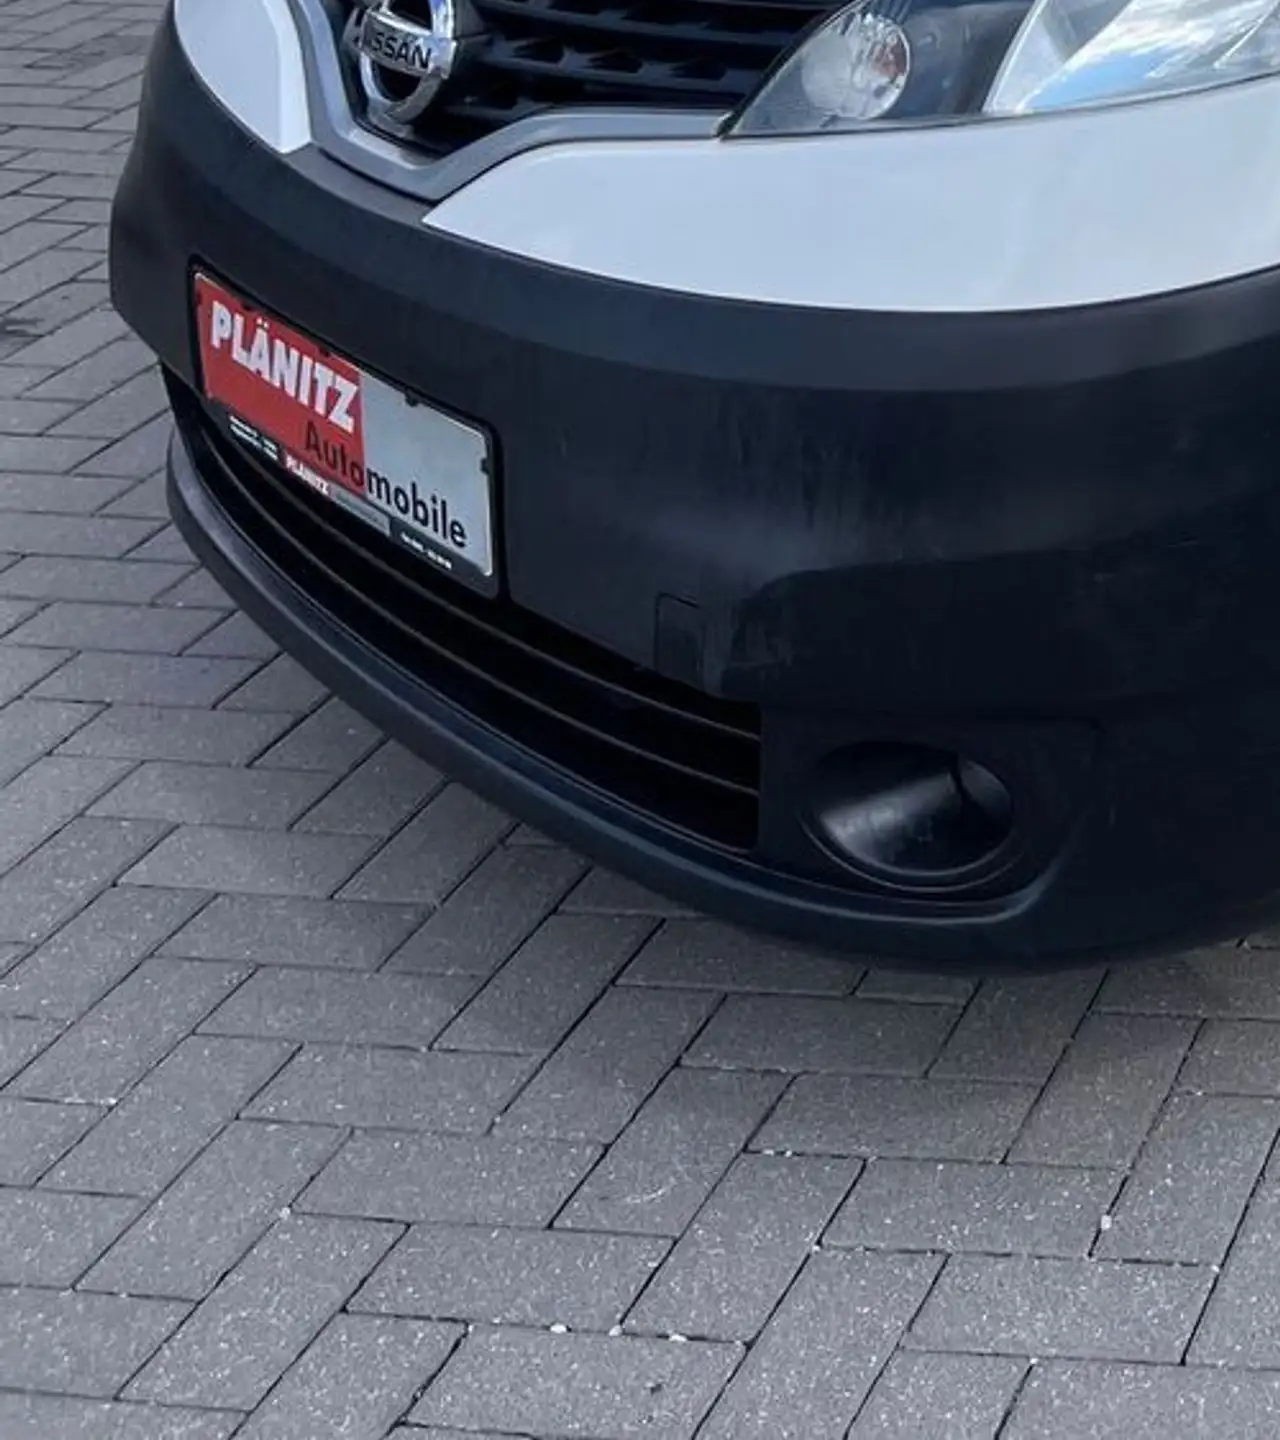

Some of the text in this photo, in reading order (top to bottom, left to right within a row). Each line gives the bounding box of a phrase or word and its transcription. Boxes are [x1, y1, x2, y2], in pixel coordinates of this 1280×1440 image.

[362, 30, 433, 70] SSAN
[210, 299, 359, 434] PLÄNITZ
[303, 420, 469, 549] Automobile
